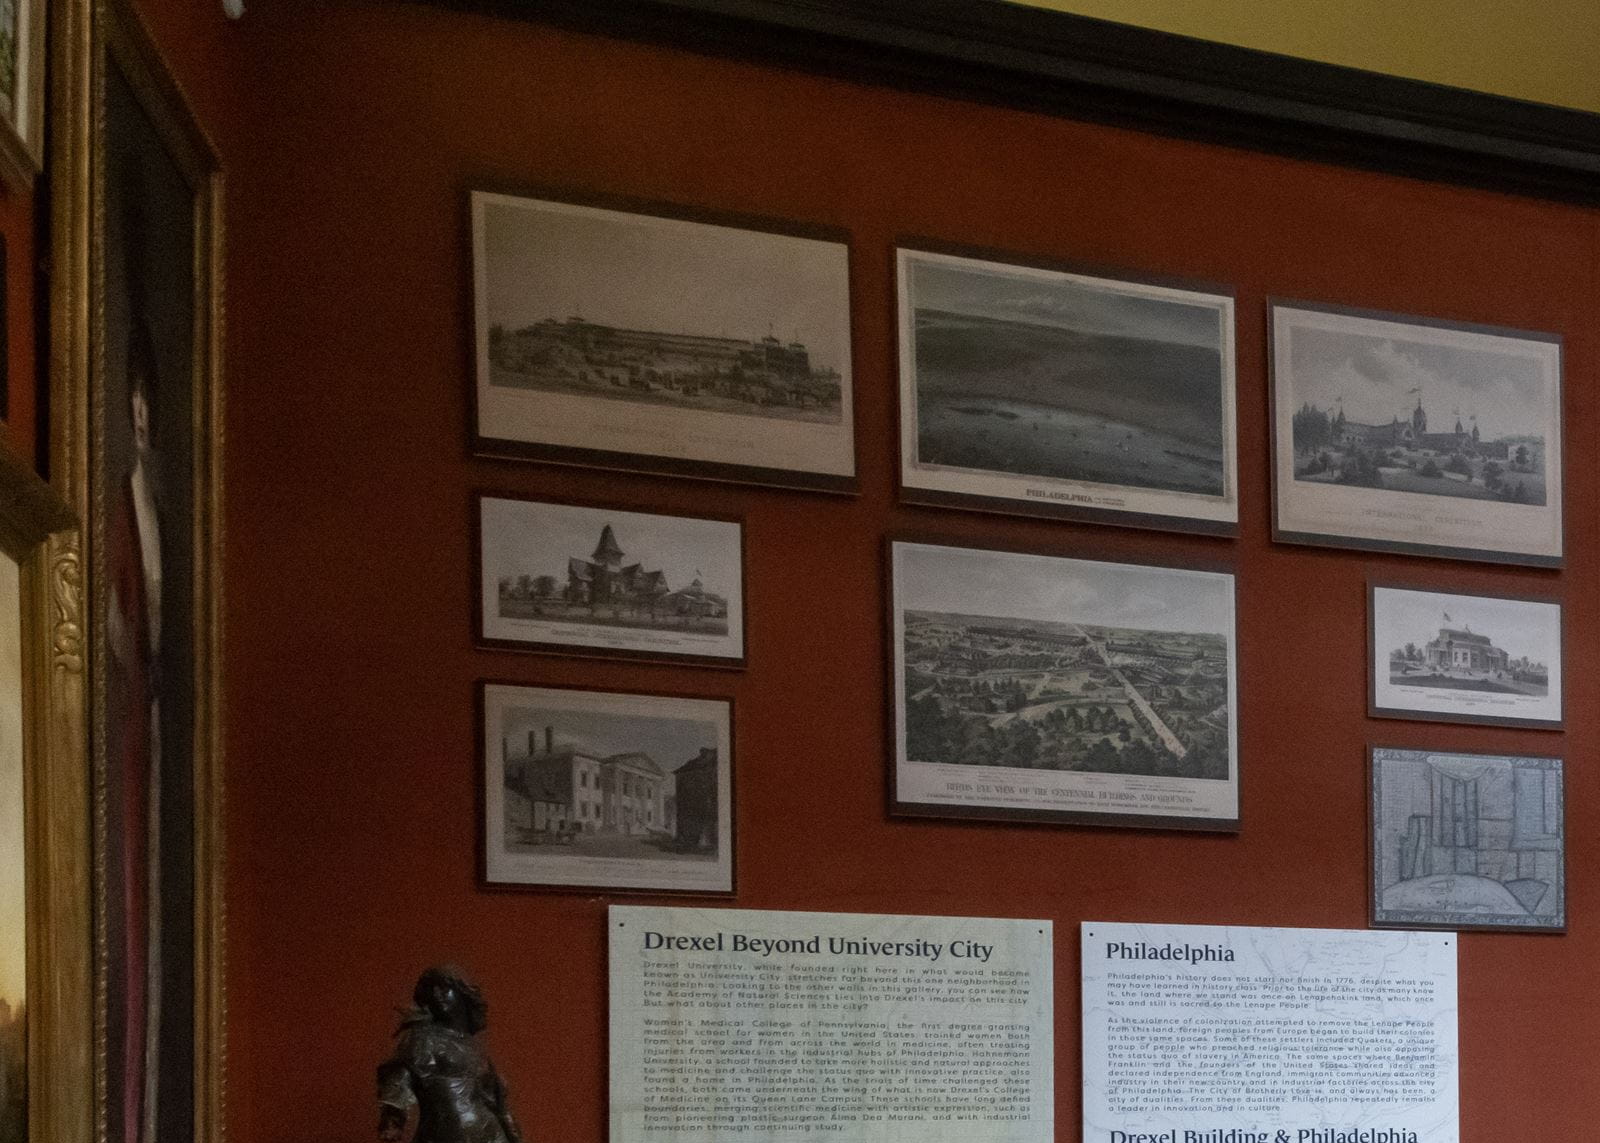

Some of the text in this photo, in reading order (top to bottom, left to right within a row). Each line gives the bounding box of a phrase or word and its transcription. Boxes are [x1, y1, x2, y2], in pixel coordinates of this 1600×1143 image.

[644, 931, 994, 962] Drexel Beyond University City
[1106, 942, 1235, 965] Philadelphia
